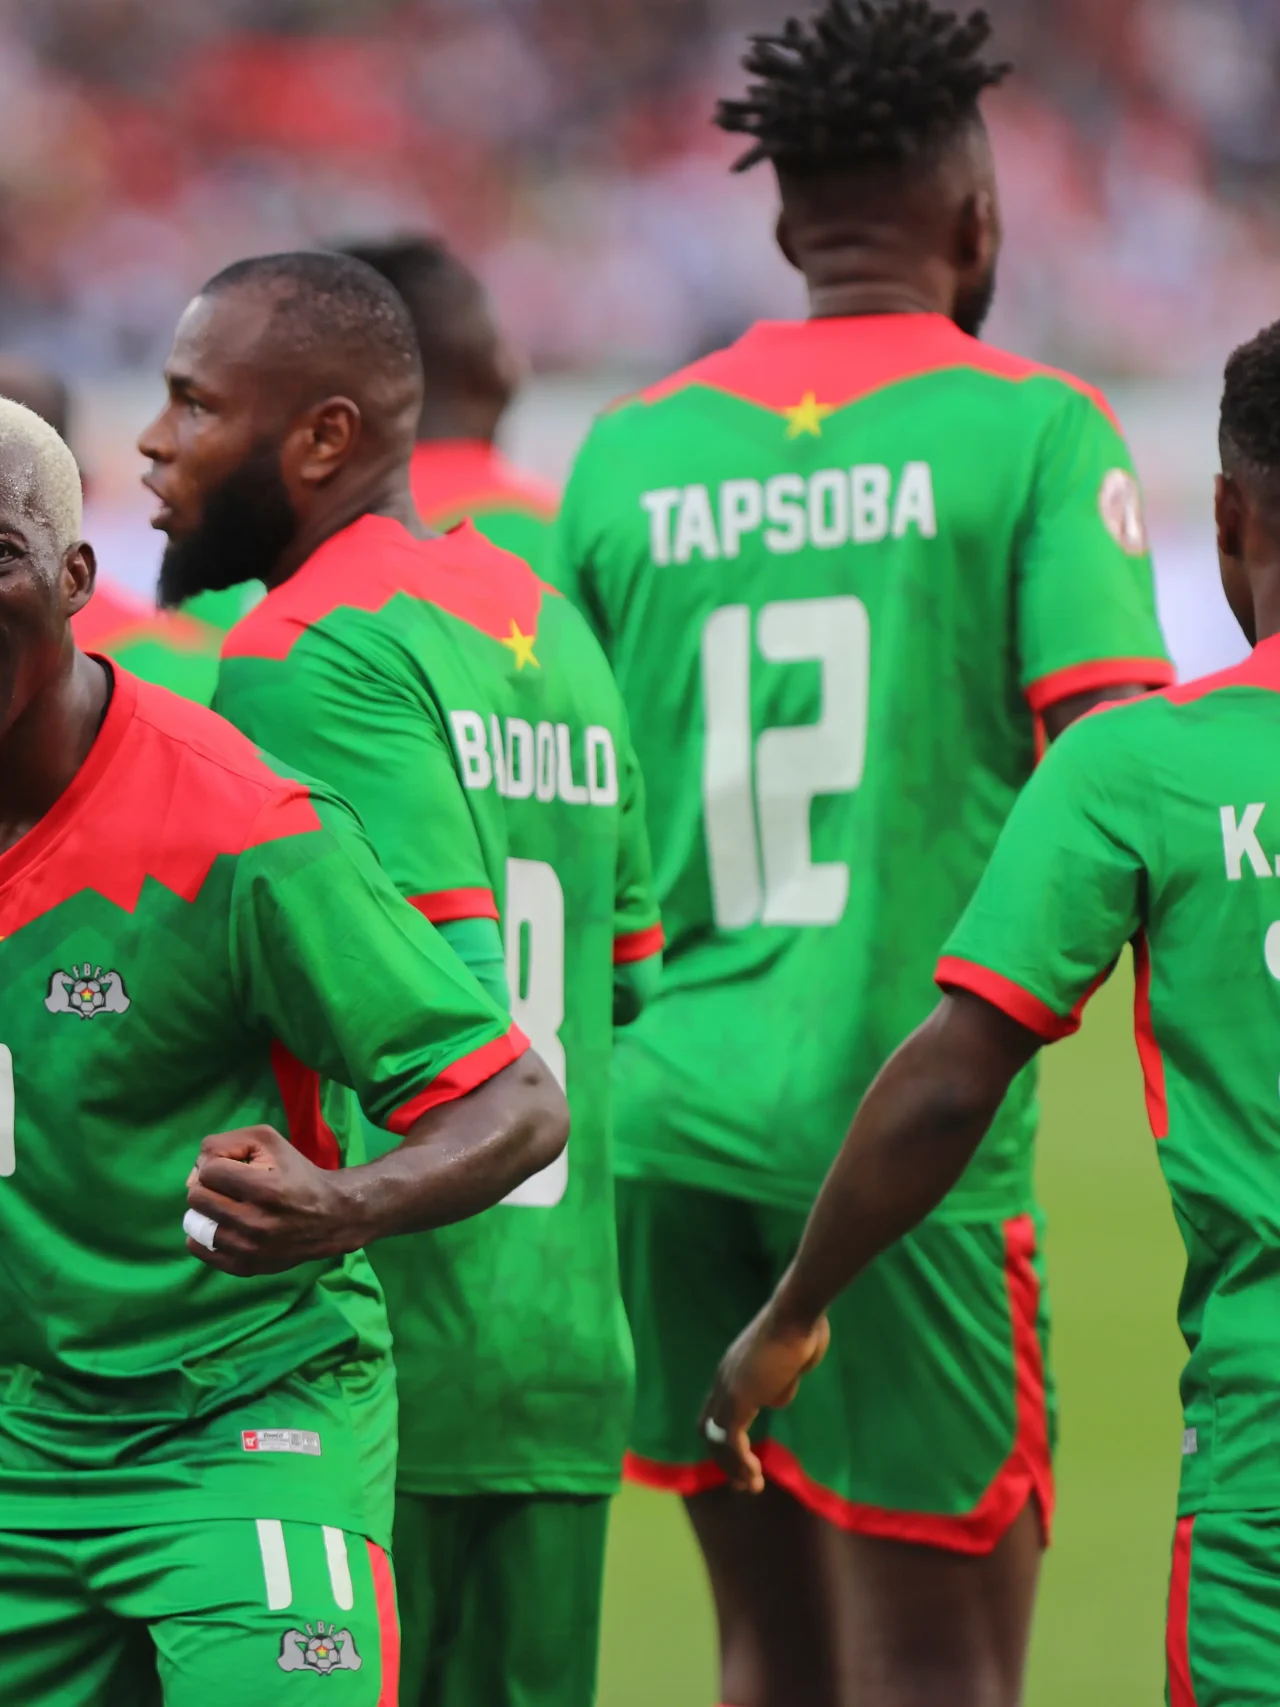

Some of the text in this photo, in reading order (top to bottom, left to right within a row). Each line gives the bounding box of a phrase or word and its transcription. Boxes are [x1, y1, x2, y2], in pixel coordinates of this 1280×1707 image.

[640, 461, 937, 567] TAPSOBA
[701, 594, 870, 930] 12
[72, 963, 102, 979] FBF
[304, 1620, 336, 1637] FBF
